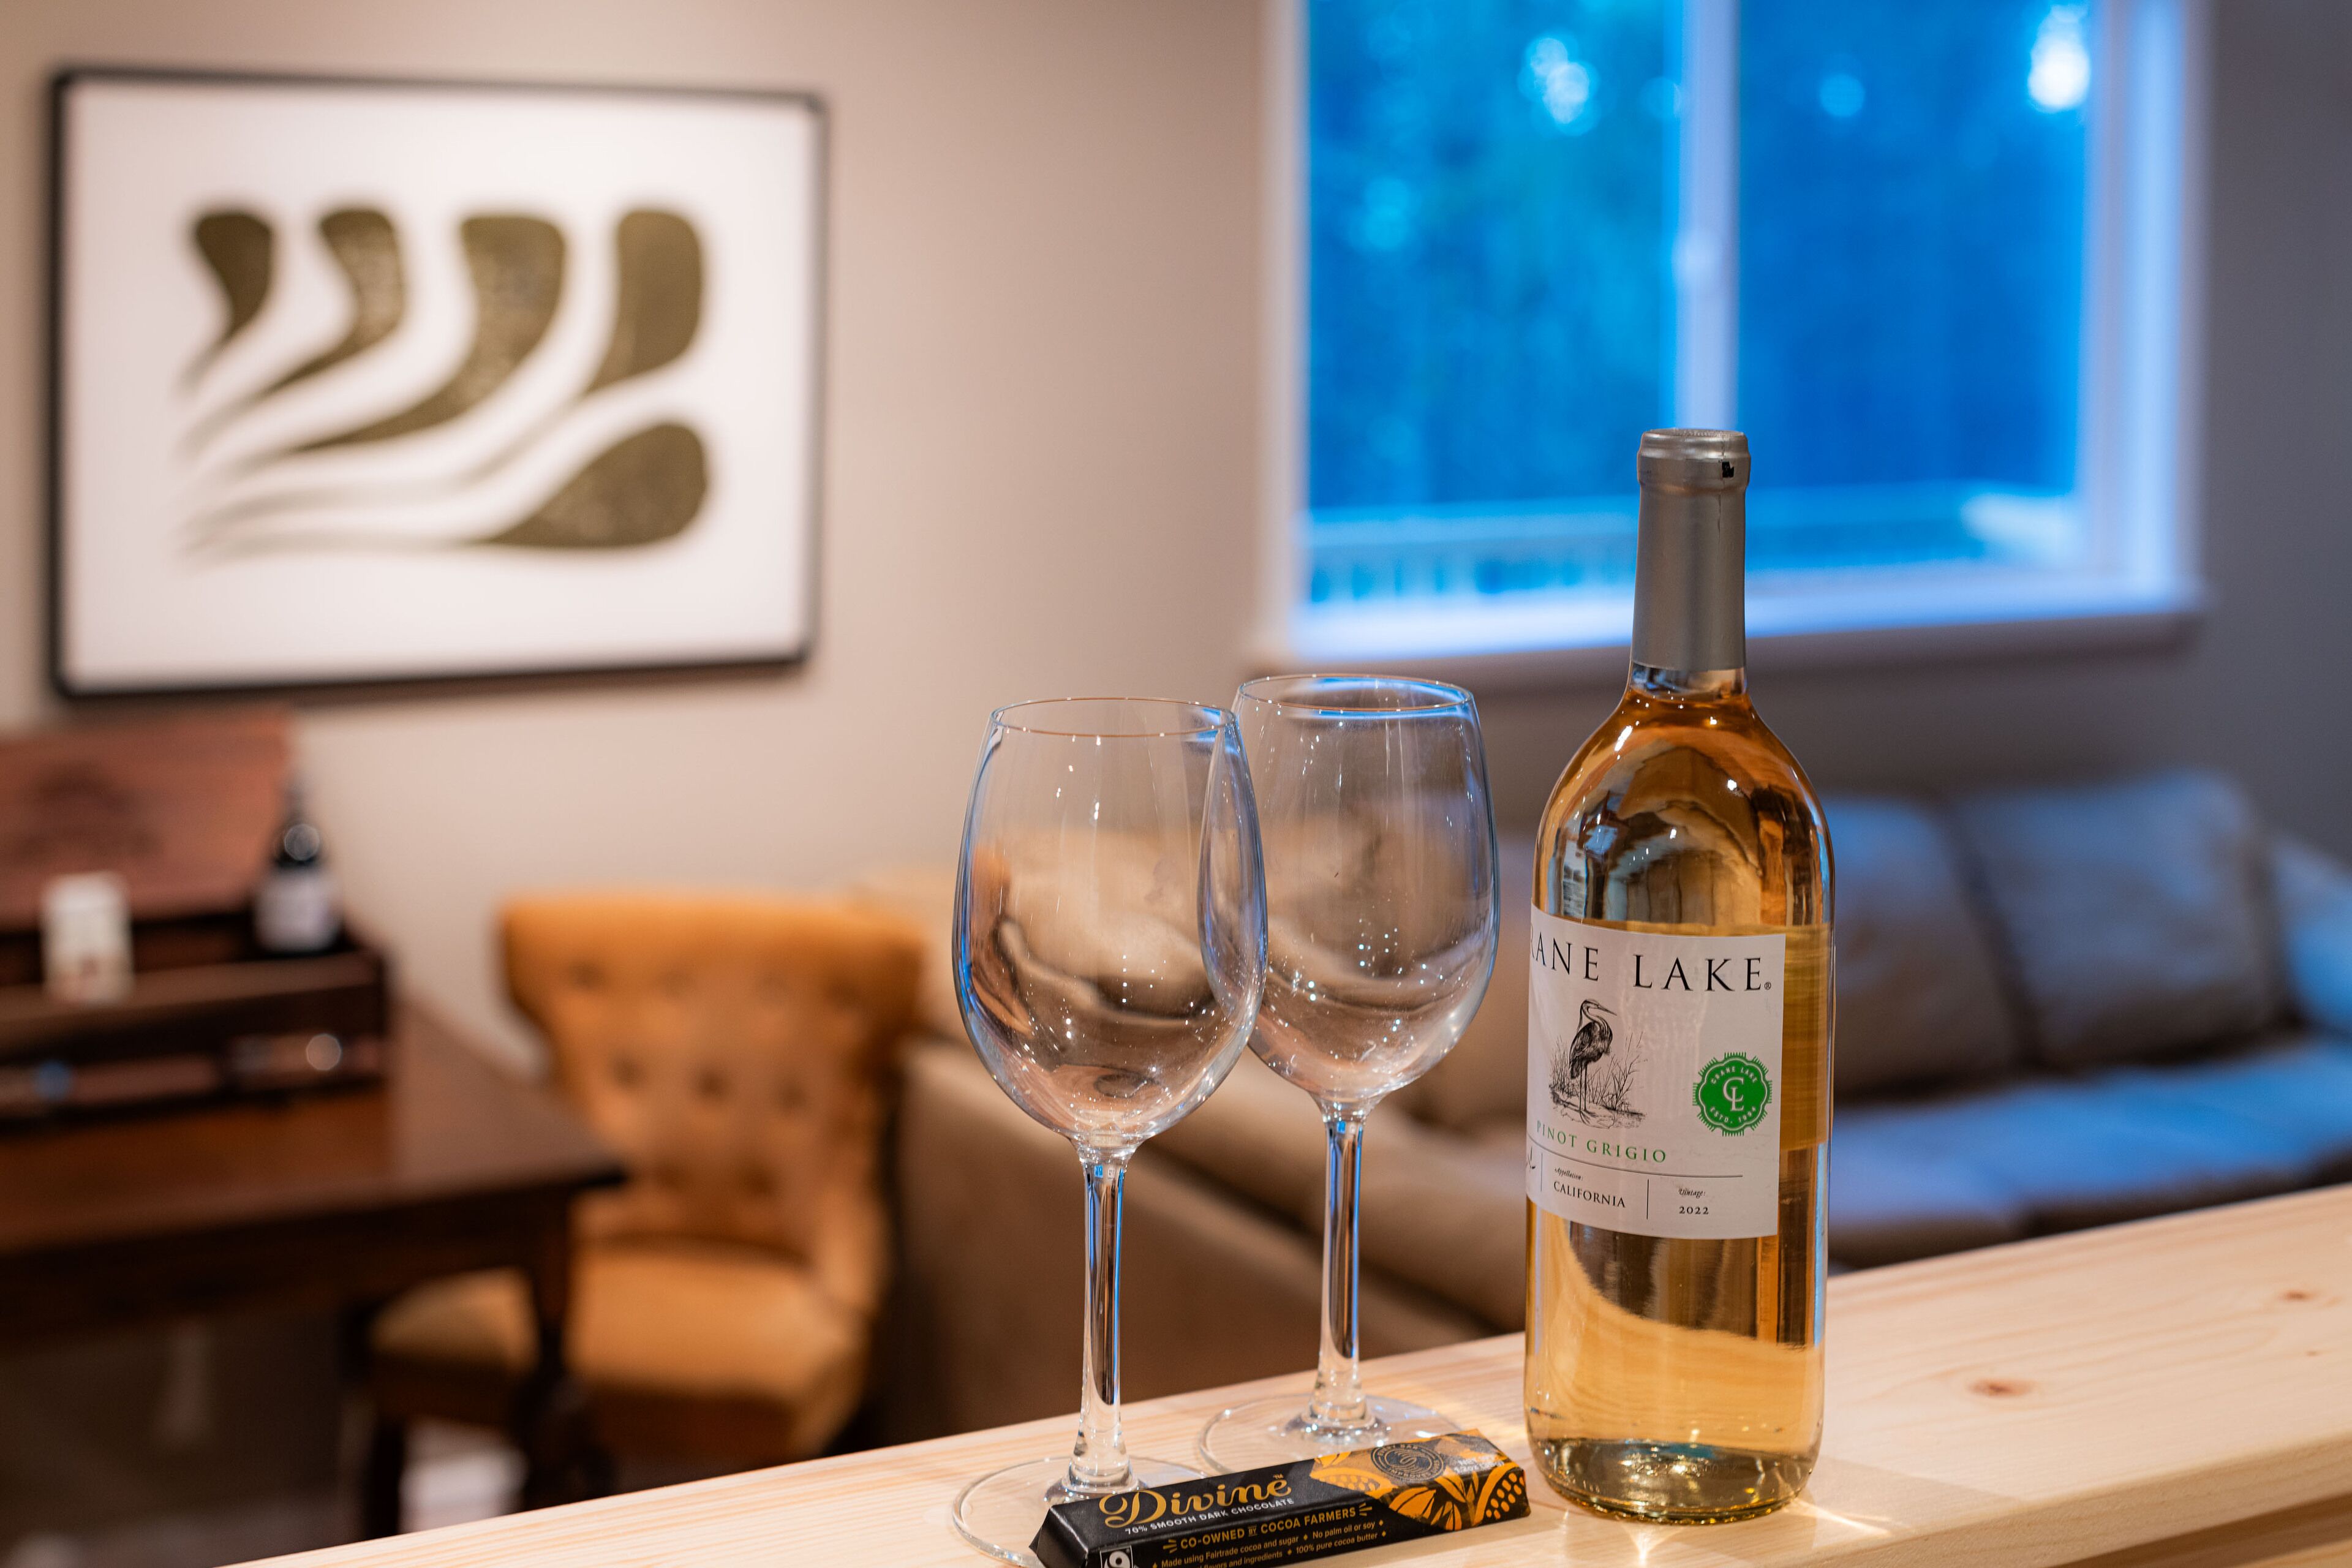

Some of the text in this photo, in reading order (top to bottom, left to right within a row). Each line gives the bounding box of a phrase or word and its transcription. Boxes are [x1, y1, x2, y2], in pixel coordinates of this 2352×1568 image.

[1531, 923, 1599, 981] ANE
[1741, 1066, 1758, 1084] LAKE
[1537, 1120, 1666, 1163] PINOT GRIGIO
[1553, 1181, 1626, 1208] CALIFORNIA
[1679, 1206, 1709, 1215] 2022
[1099, 1479, 1292, 1528] Divine
[1125, 1498, 1294, 1535] 70% SMOOTH DARK CHOCOLATE
[1161, 1558, 1182, 1568] Made
[1184, 1554, 1204, 1564] using
[1206, 1547, 1238, 1560] Fairtrade
[1240, 1543, 1262, 1554] cocoa
[1264, 1539, 1277, 1549] and
[1278, 1536, 1299, 1547] sugar
[1313, 1531, 1323, 1539] No
[1325, 1528, 1342, 1539] palm
[1344, 1525, 1352, 1533] oil
[1363, 1521, 1376, 1531] soy
[1181, 1507, 1356, 1549] CO-OWNED BY COCOA FARMERS
[1229, 1557, 1242, 1567] and
[1244, 1550, 1283, 1564] ingredients
[1296, 1544, 1314, 1554] 100%
[1316, 1541, 1332, 1551] pure
[1334, 1537, 1355, 1547] cocoa
[1357, 1532, 1378, 1542] butter
